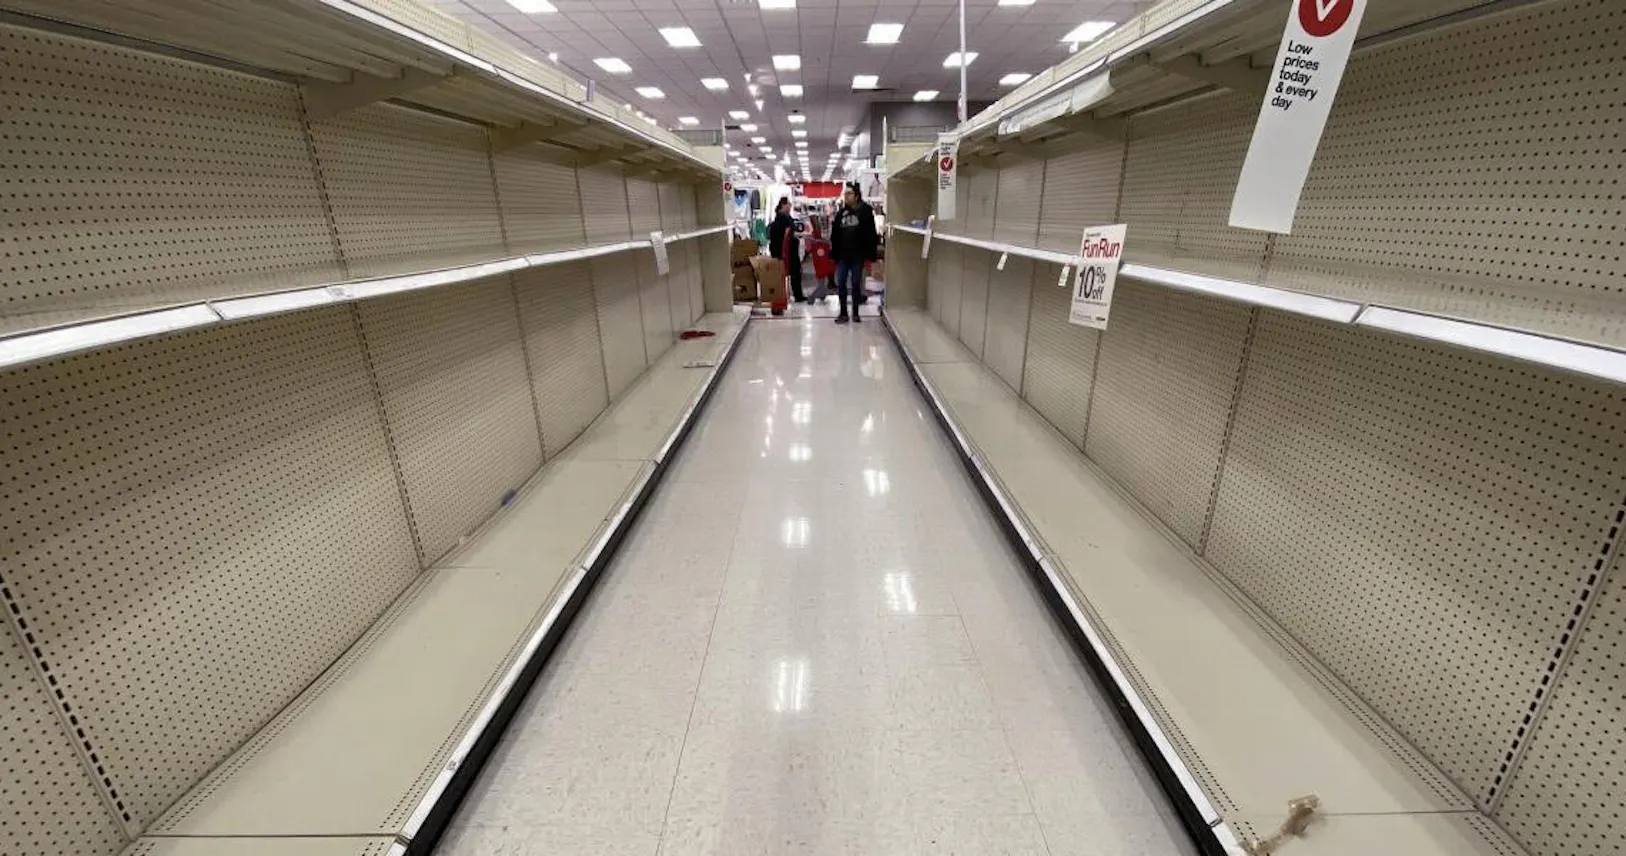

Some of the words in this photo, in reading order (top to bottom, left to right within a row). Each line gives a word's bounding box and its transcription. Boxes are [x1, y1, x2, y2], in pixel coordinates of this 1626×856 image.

[1288, 40, 1313, 55] Low
[1282, 56, 1320, 72] prices
[1279, 70, 1312, 86] today
[1275, 81, 1284, 93] &
[1285, 85, 1318, 101] every
[1271, 95, 1293, 111] day
